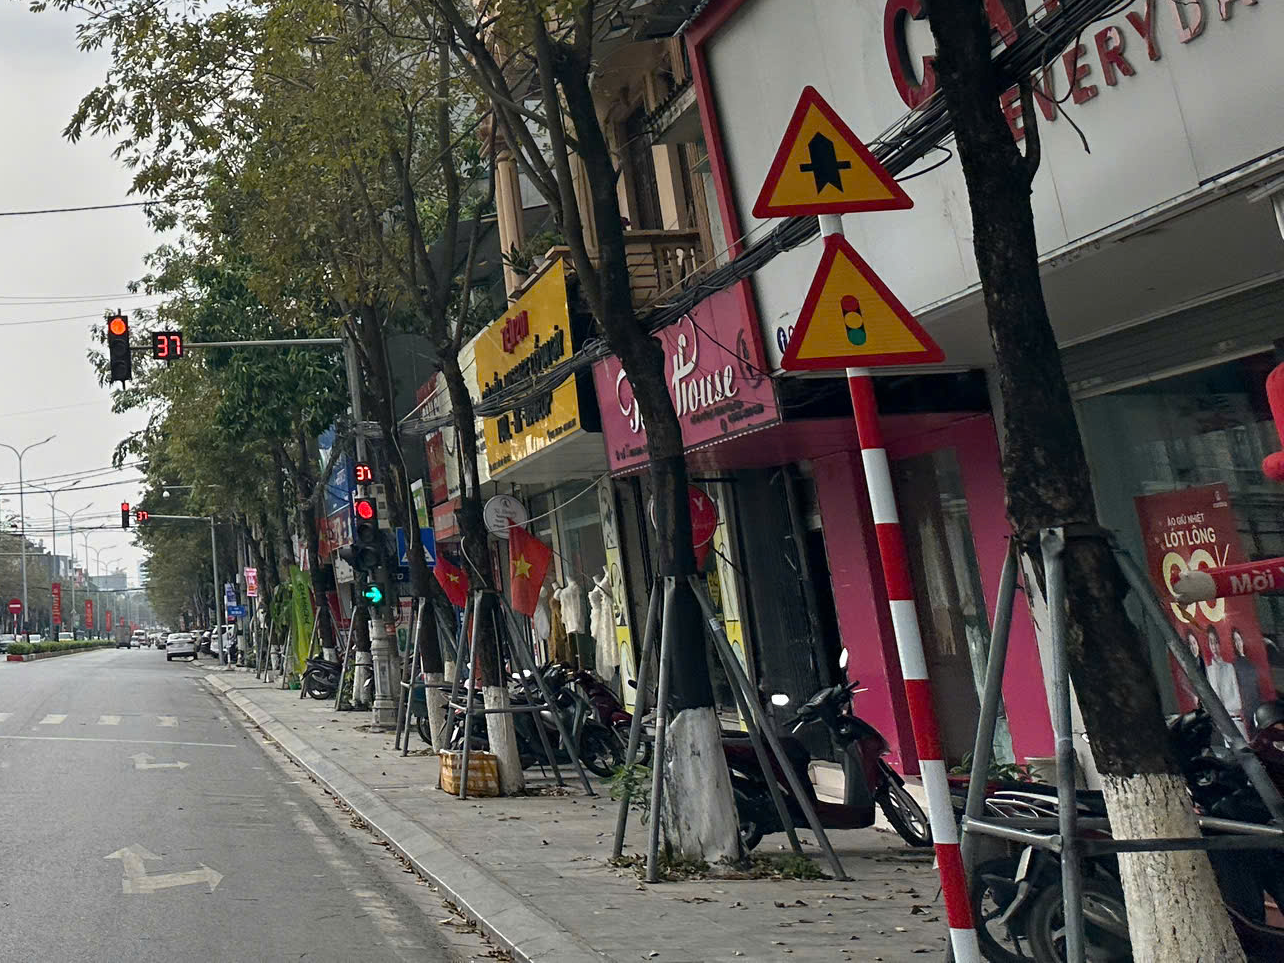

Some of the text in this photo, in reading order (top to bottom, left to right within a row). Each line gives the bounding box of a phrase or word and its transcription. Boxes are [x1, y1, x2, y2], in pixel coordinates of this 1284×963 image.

[157, 335, 181, 357] 37
[356, 466, 372, 480] 37
[137, 511, 148, 521] 37
[1186, 524, 1216, 545] LÔNG
[1229, 568, 1275, 595] Mời
